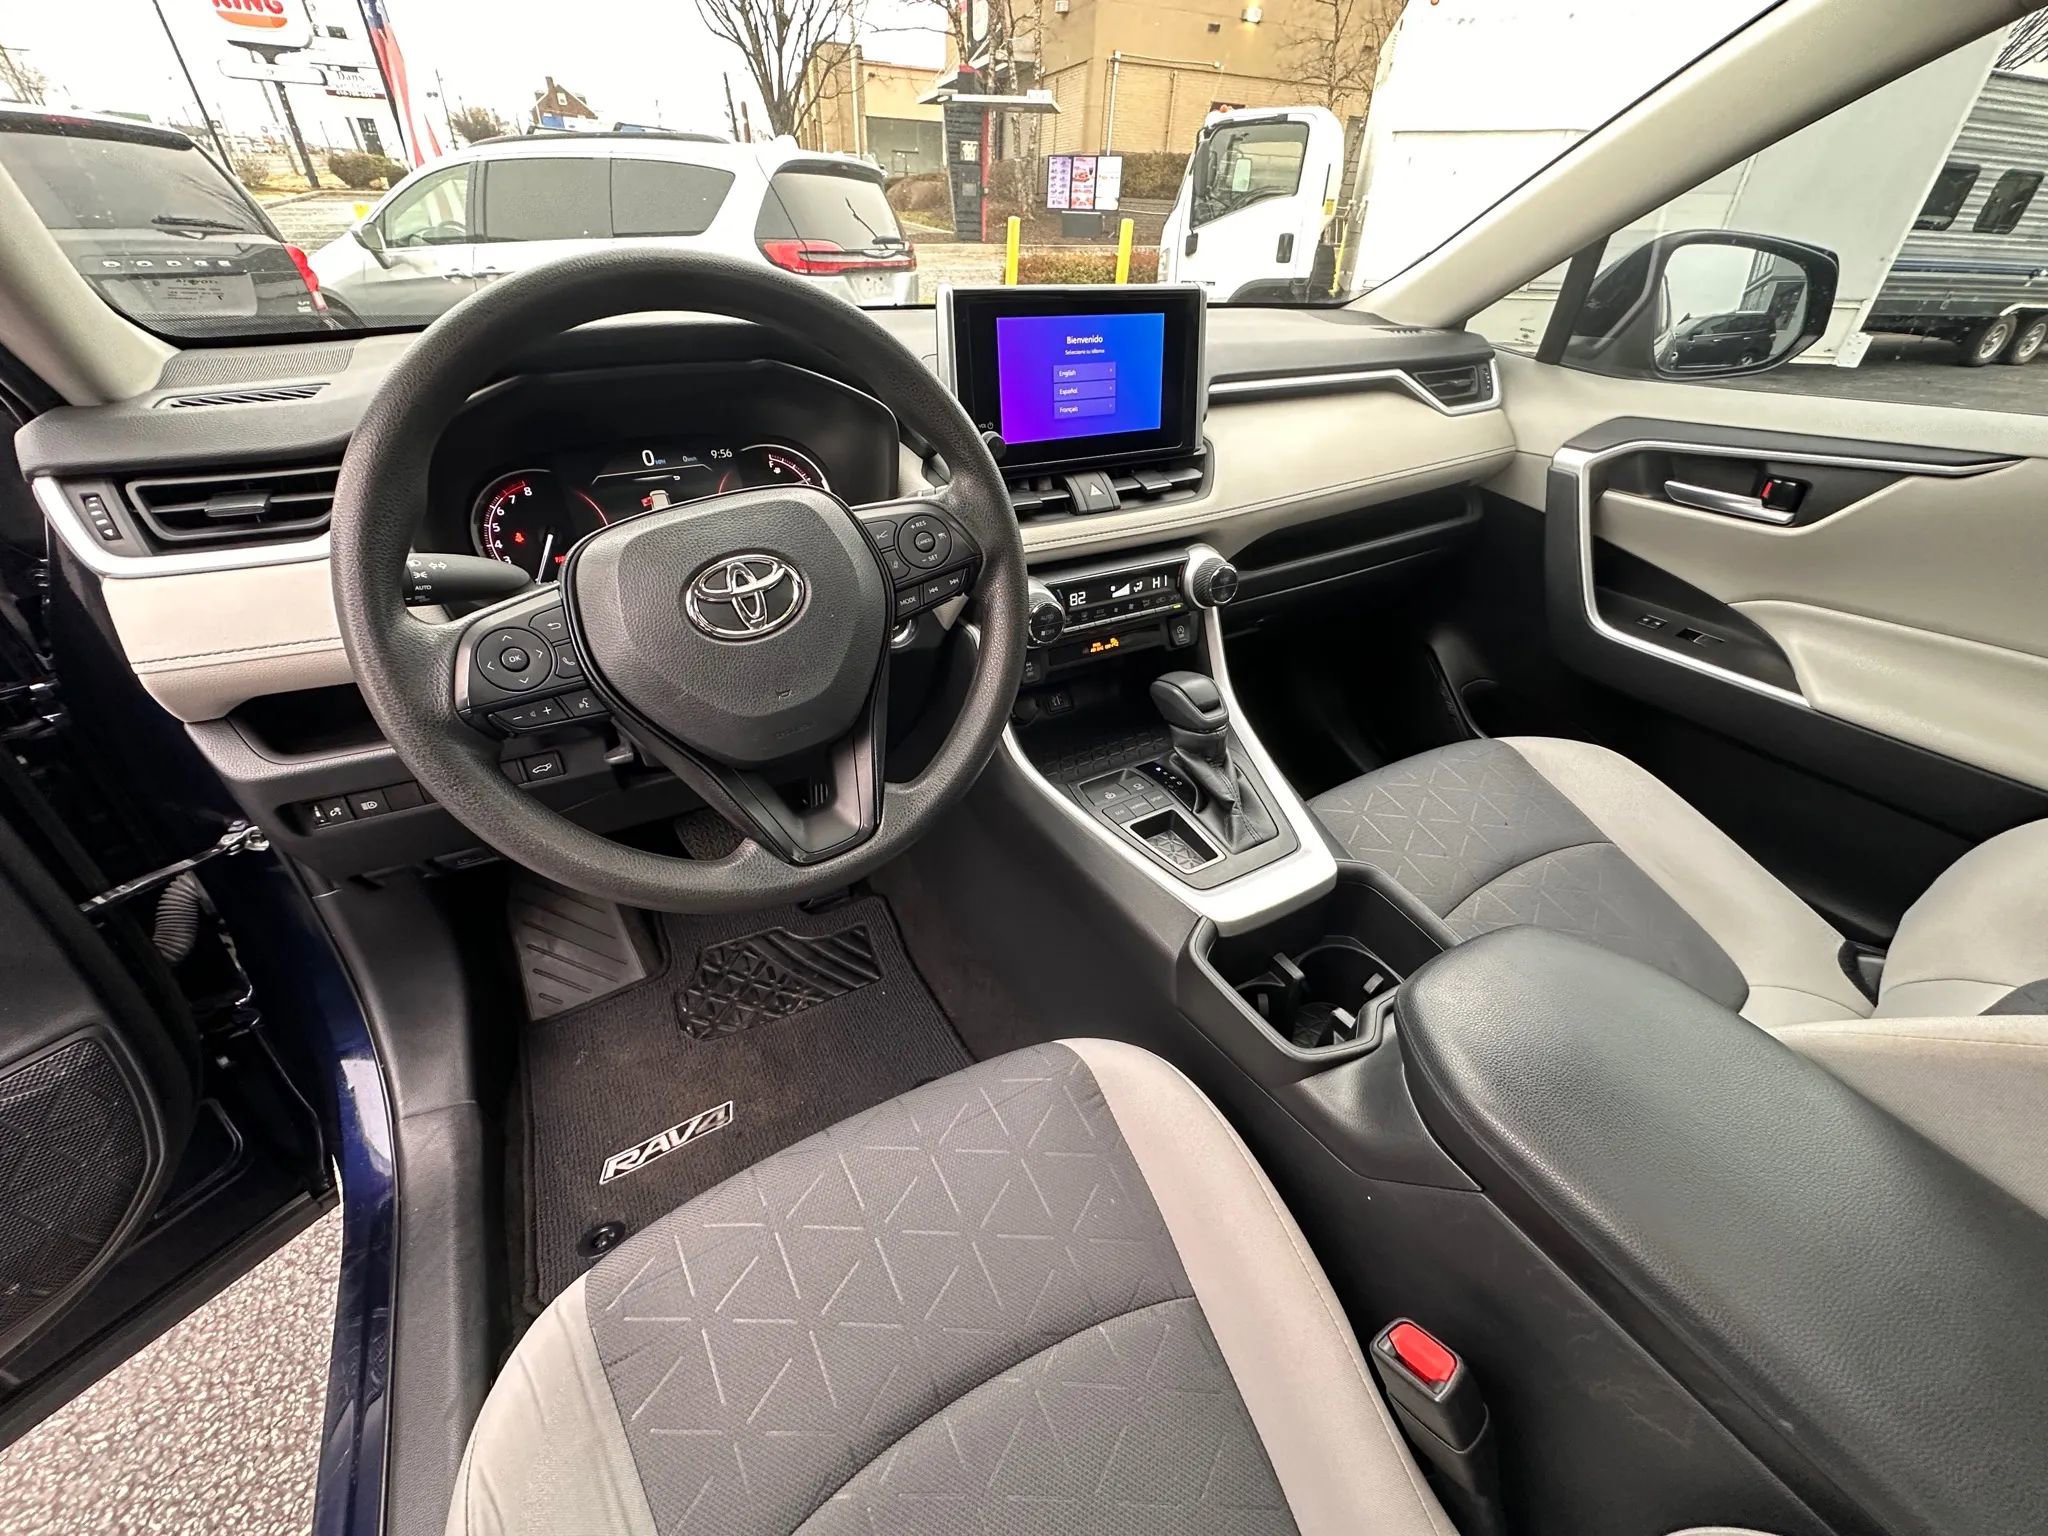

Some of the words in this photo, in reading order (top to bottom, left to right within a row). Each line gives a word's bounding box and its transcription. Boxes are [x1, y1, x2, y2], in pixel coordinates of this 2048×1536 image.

[102, 259, 231, 268] DODGE
[1066, 335, 1103, 344] Bienvenido
[1059, 387, 1078, 395] Español
[641, 449, 655, 467] 0
[710, 448, 733, 459] 9:56
[523, 486, 533, 496] 8
[508, 494, 516, 504] 7
[496, 506, 505, 516] 6
[492, 522, 501, 532] 5
[494, 539, 503, 549] 4
[503, 555, 512, 565] 3
[1152, 574, 1168, 589] HI
[899, 596, 917, 606] MODE
[1069, 591, 1086, 606] 82
[509, 654, 522, 663] OK
[604, 1106, 729, 1180] RAV4
